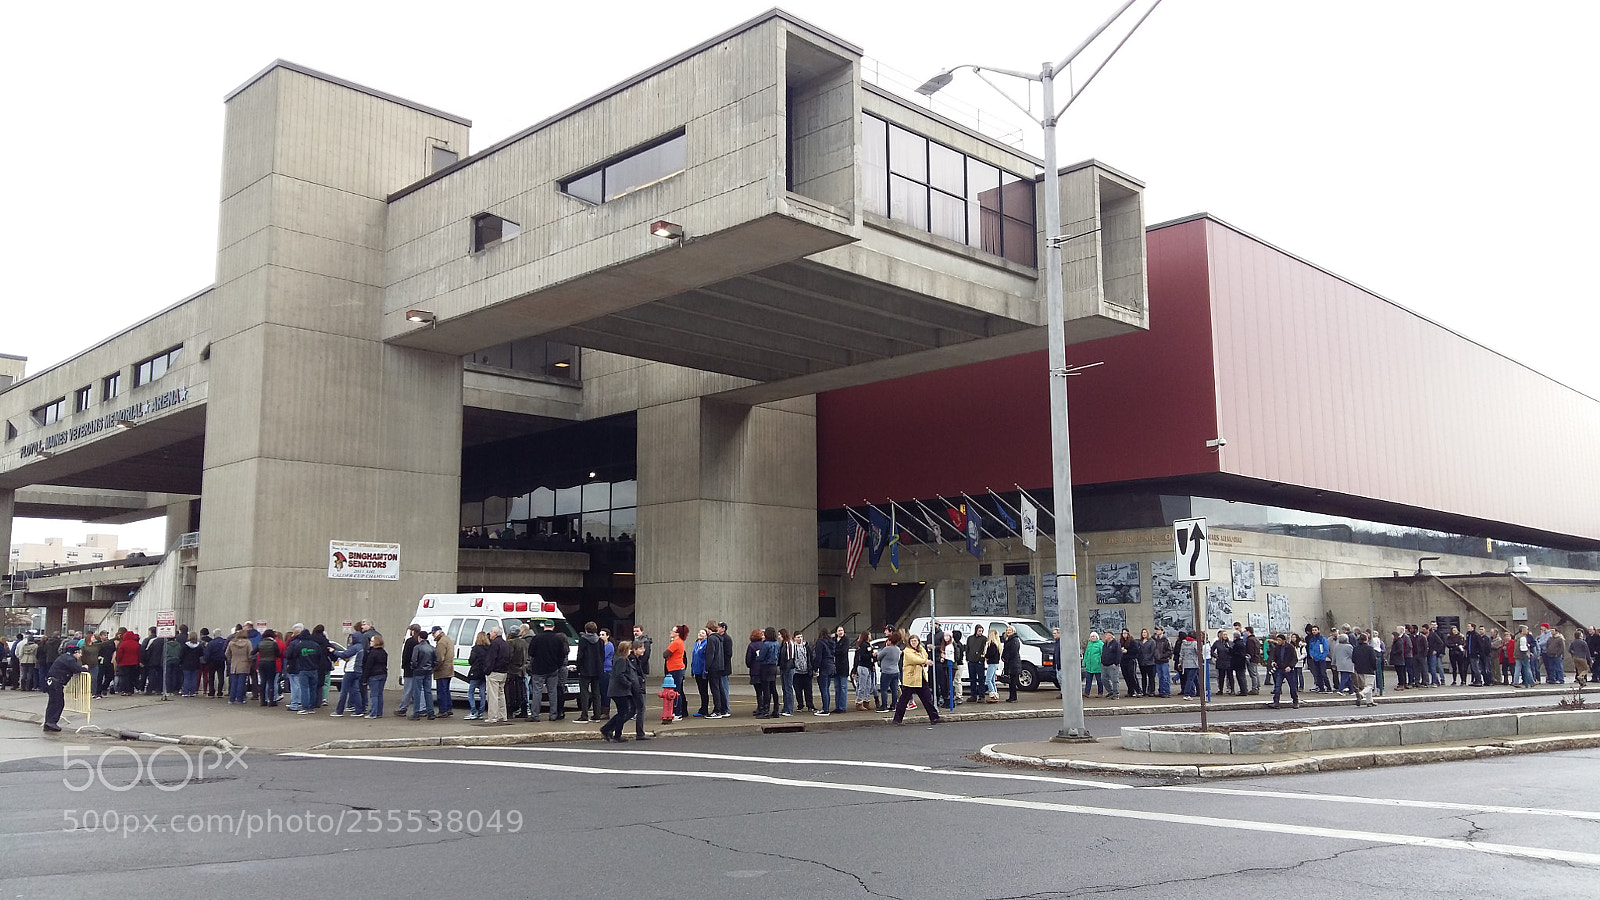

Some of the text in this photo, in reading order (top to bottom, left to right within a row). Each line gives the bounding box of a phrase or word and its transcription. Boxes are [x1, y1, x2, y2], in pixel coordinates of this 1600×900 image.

[45, 430, 68, 450] MAINES
[69, 417, 104, 442] VETERANS
[104, 402, 144, 429] MEMORIAL
[152, 388, 181, 413] ARENA
[348, 552, 398, 561] BINGHAMTON
[348, 560, 387, 568] SENATORS
